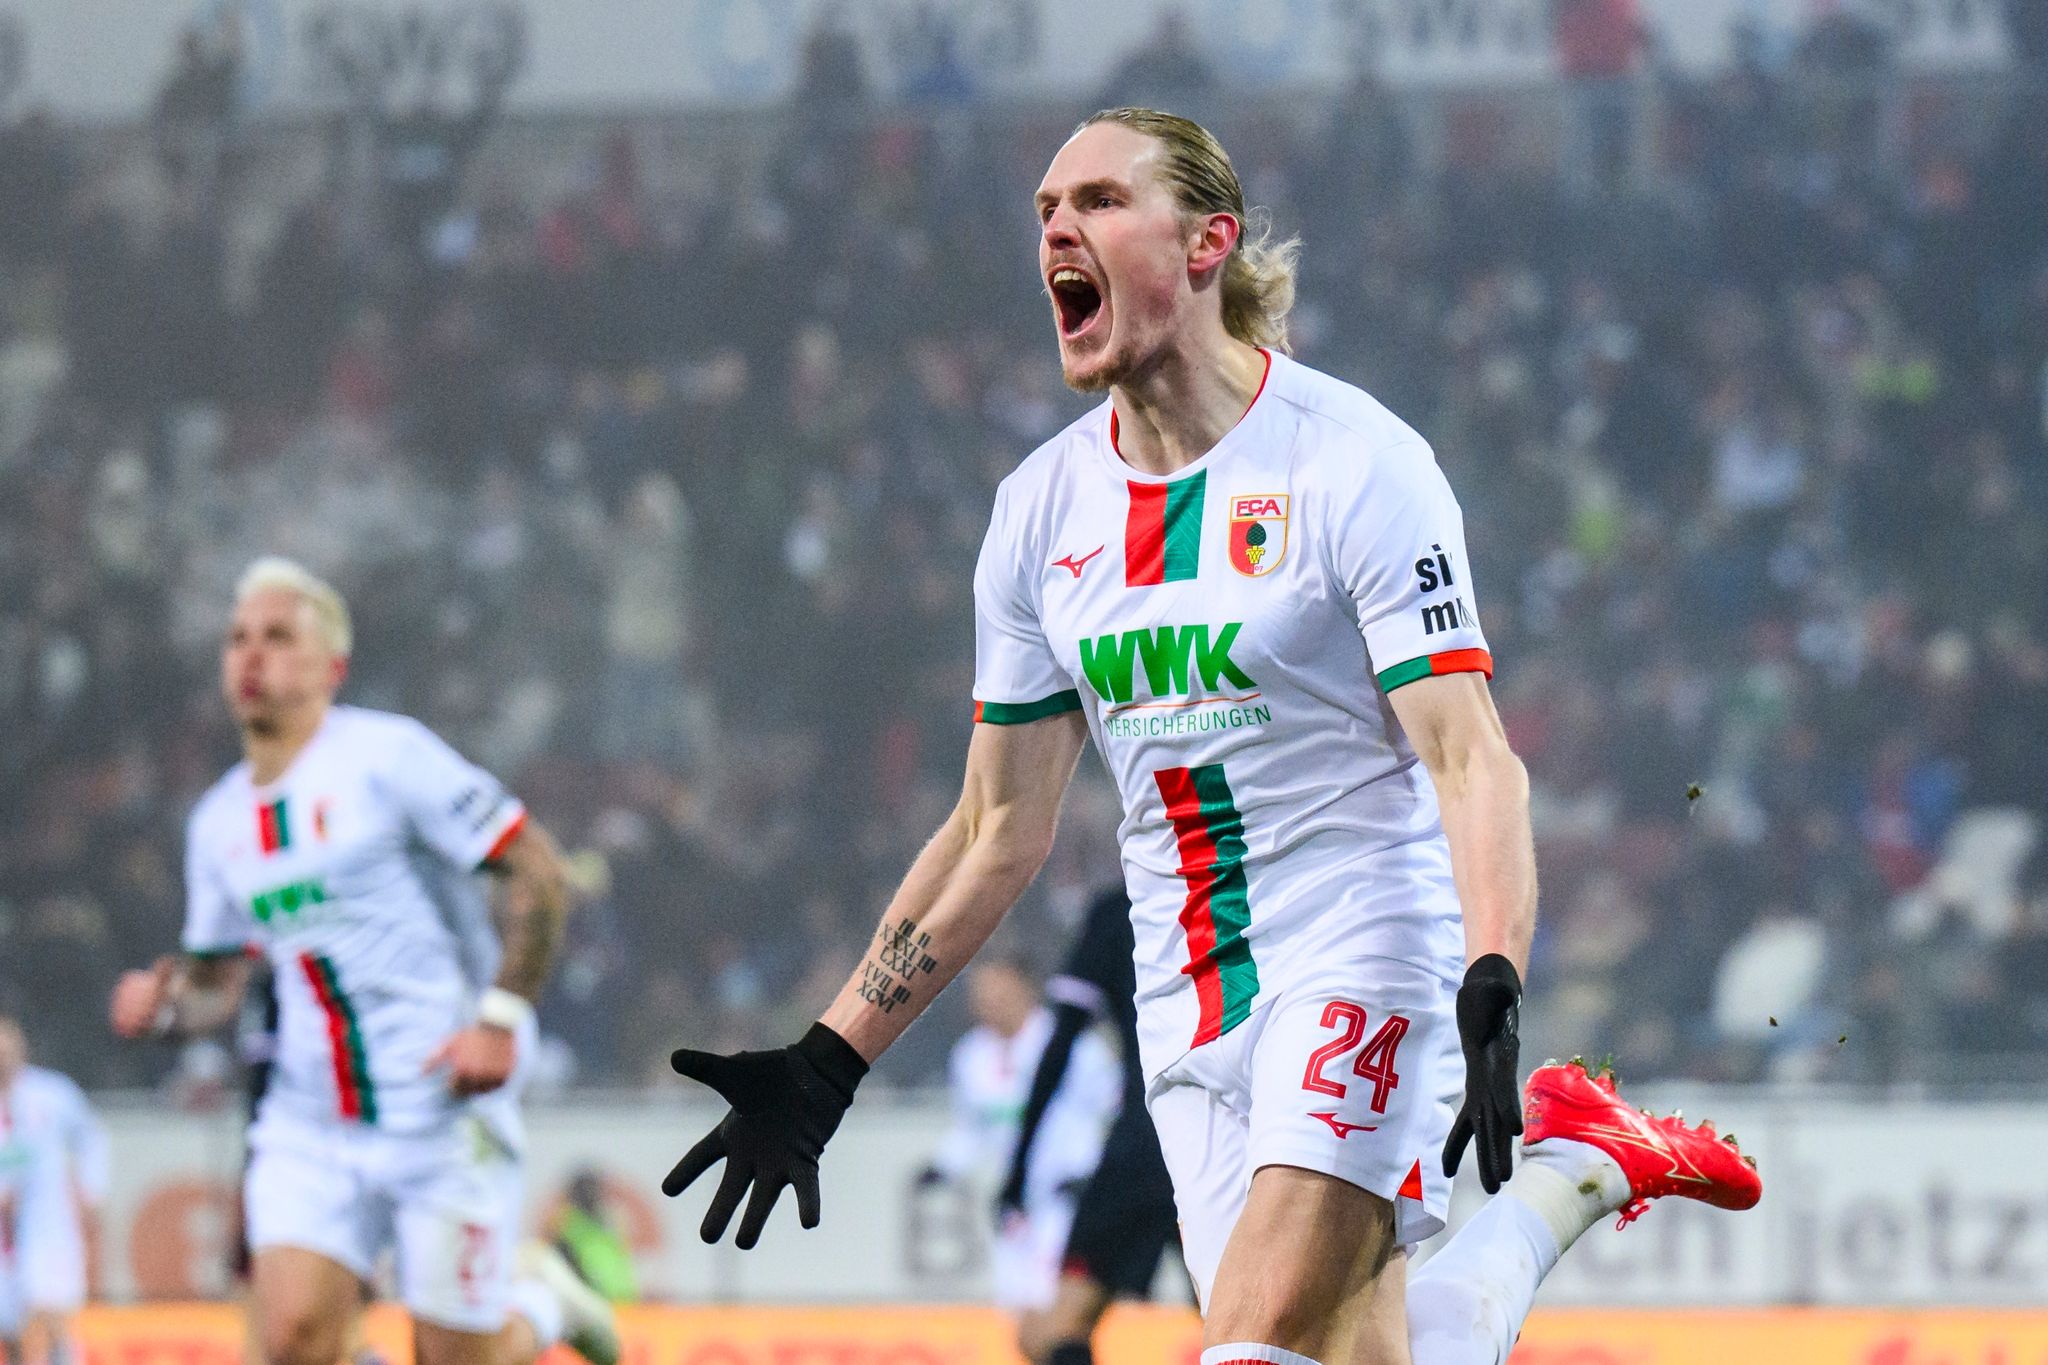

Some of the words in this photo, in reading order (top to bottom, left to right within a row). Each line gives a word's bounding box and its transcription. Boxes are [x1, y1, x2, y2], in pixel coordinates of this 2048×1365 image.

[1236, 498, 1282, 518] FCA
[1414, 543, 1453, 594] si
[1078, 622, 1260, 704] WWK
[1103, 704, 1272, 737] VERSICHERUNGEN
[1301, 1000, 1411, 1114] 24
